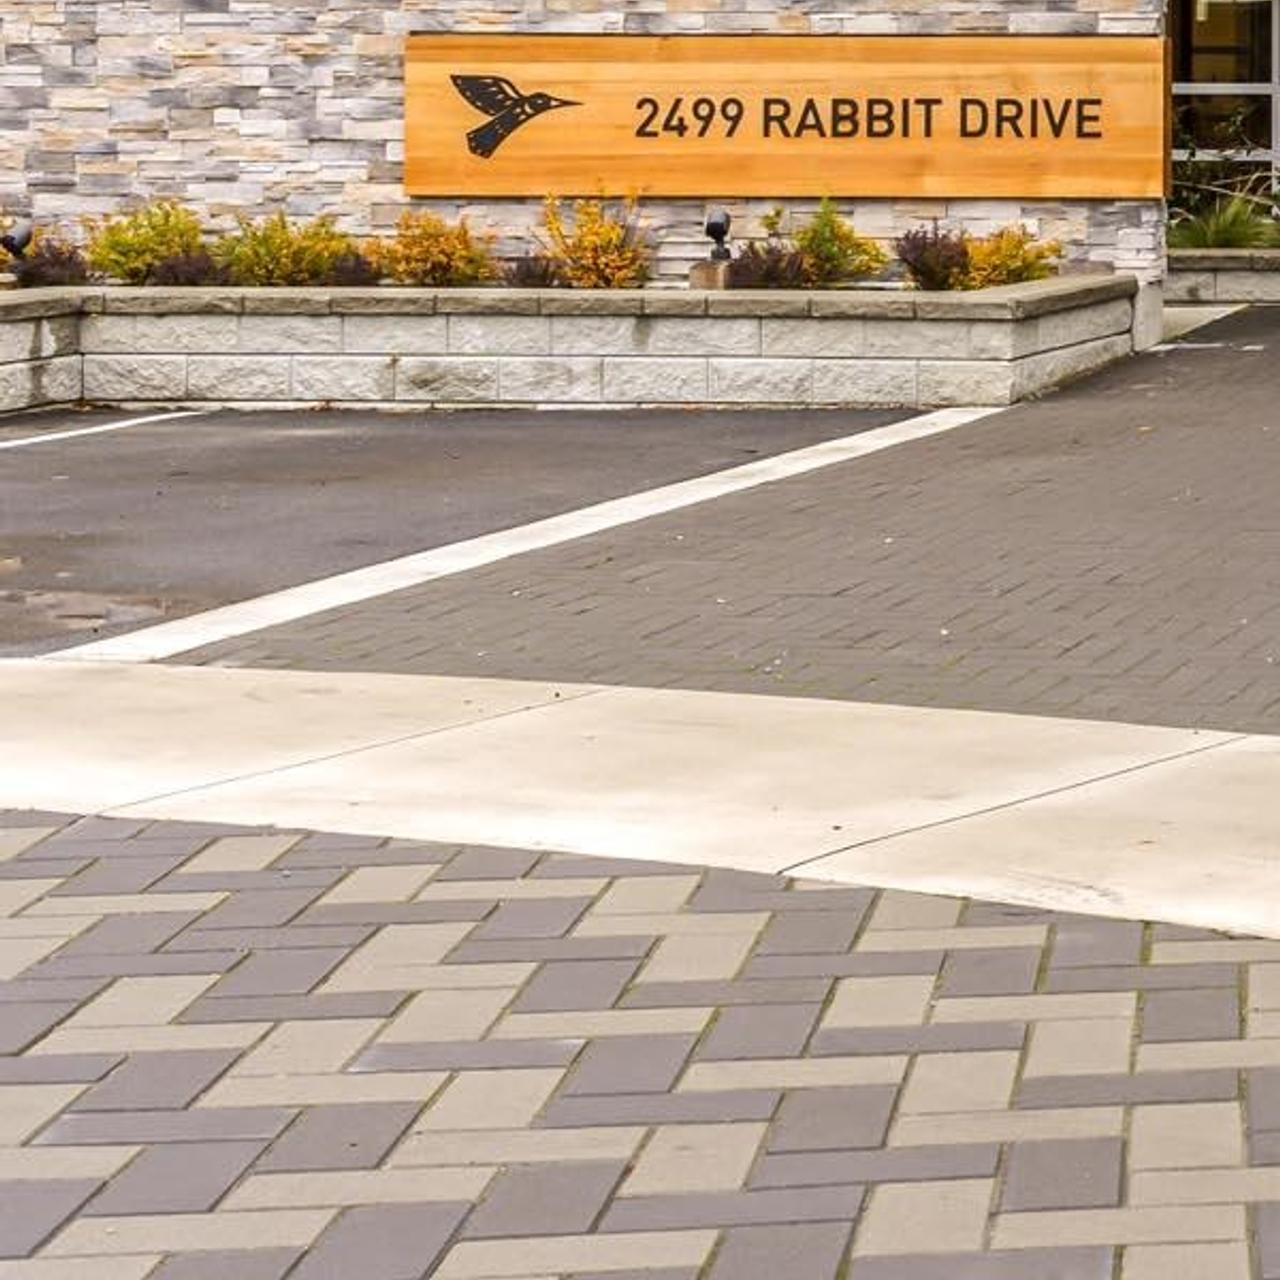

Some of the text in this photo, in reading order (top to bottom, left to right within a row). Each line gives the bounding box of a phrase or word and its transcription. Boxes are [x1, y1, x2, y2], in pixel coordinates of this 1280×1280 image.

[635, 97, 1102, 139] 2499 RABBIT DRIVE
